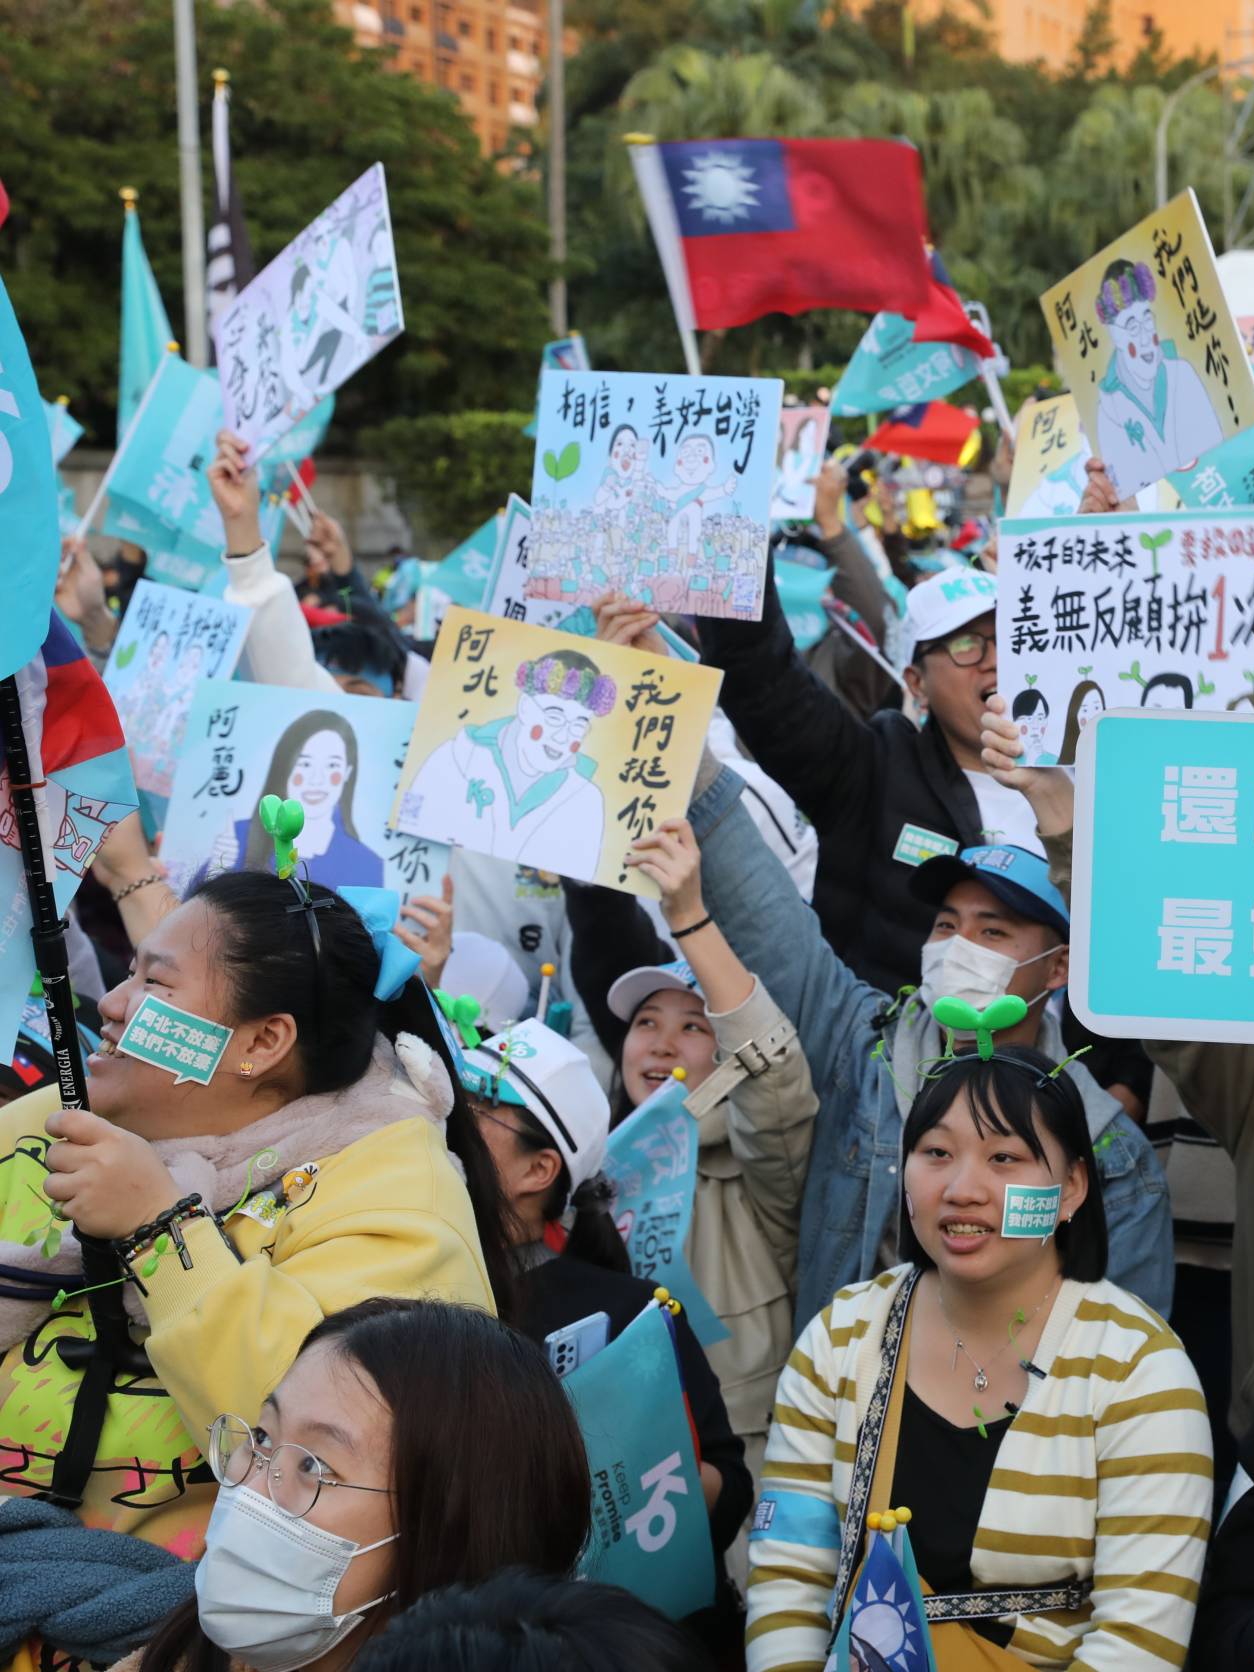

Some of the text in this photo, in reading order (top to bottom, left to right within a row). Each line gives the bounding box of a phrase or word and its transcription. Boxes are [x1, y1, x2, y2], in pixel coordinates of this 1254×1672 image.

[128, 1025, 215, 1072] 我們不放棄
[138, 1007, 224, 1054] 阿北不放棄
[56, 1047, 76, 1097] ENERGIA
[593, 1468, 623, 1543] Promise
